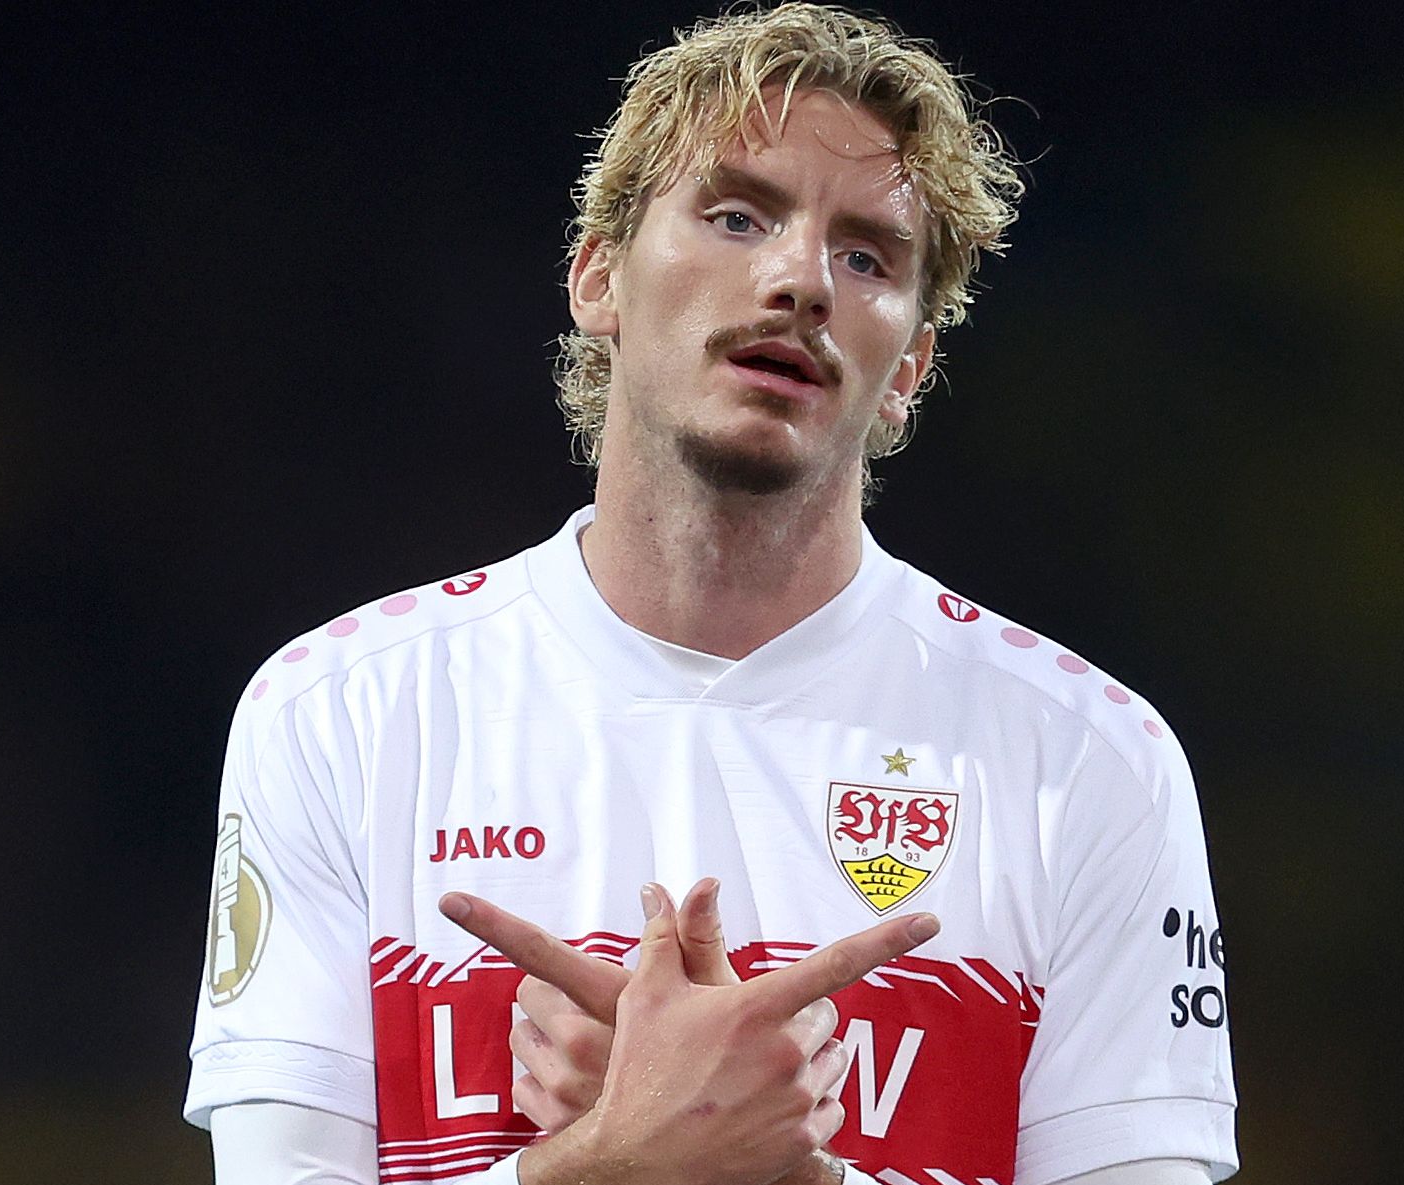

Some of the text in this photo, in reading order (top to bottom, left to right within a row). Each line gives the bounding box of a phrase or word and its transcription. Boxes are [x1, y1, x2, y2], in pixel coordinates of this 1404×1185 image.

[834, 790, 952, 852] VfB
[429, 825, 546, 863] JAKO
[854, 846, 921, 863] 18 93
